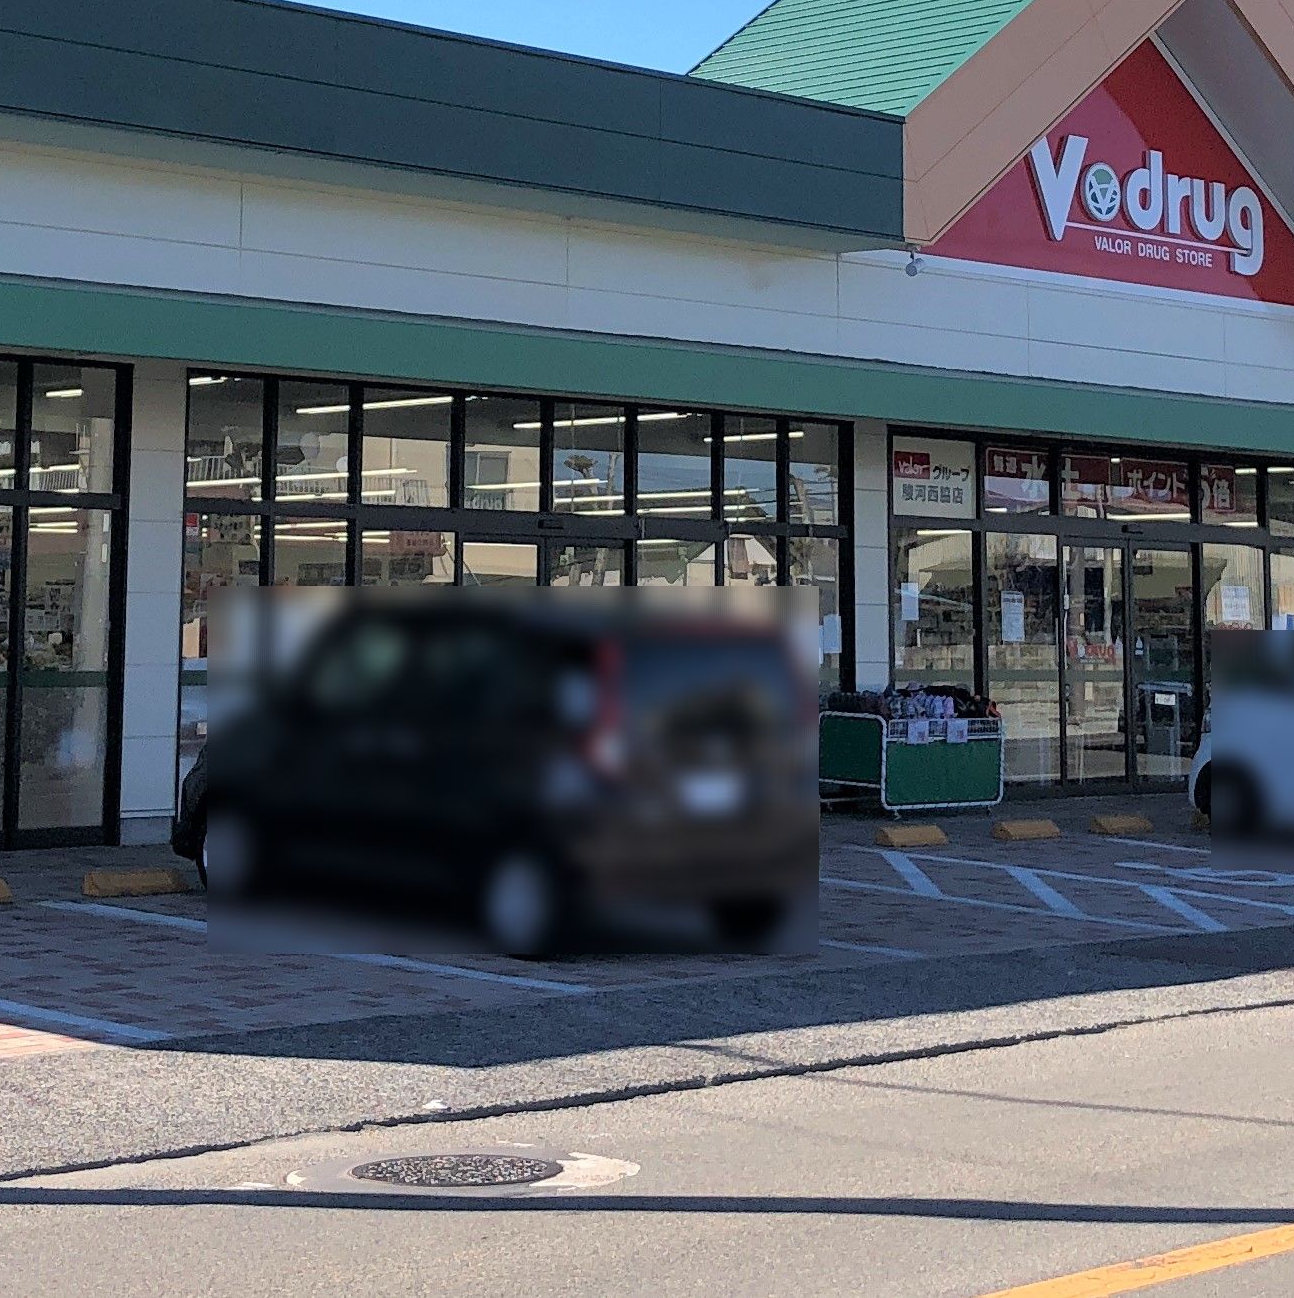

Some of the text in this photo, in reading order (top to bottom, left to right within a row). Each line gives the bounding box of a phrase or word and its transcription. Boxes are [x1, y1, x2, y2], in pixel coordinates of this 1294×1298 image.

[1094, 235, 1213, 269] VALOR DRUG STORE
[932, 463, 971, 482] グループ
